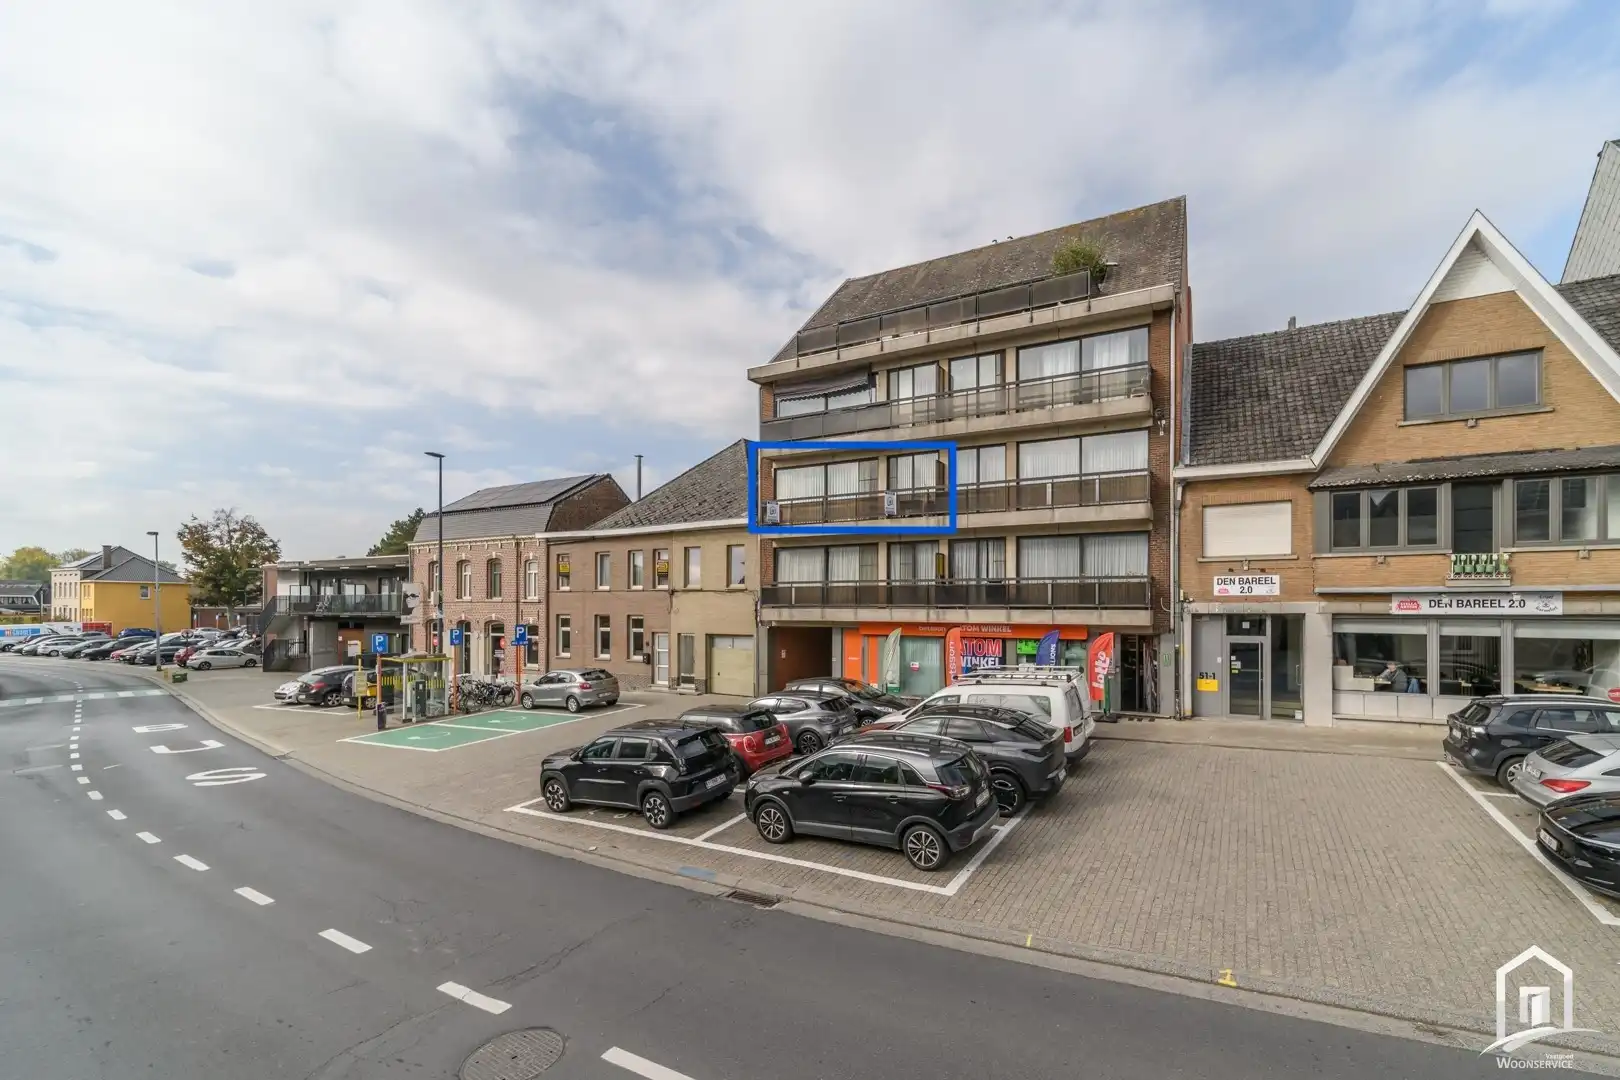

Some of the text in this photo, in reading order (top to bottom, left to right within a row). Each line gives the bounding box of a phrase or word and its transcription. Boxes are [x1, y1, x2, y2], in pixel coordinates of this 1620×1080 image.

[1217, 576, 1276, 586] DEN BAREEL
[1239, 586, 1253, 594] 2.0
[1428, 599, 1526, 609] DEN BAREEL 2.0
[516, 626, 525, 638] P
[960, 624, 1012, 633] TOM WINKEL
[452, 629, 460, 640] P
[375, 635, 384, 646] P
[1091, 650, 1110, 689] lotto
[1199, 671, 1216, 680] 51-1
